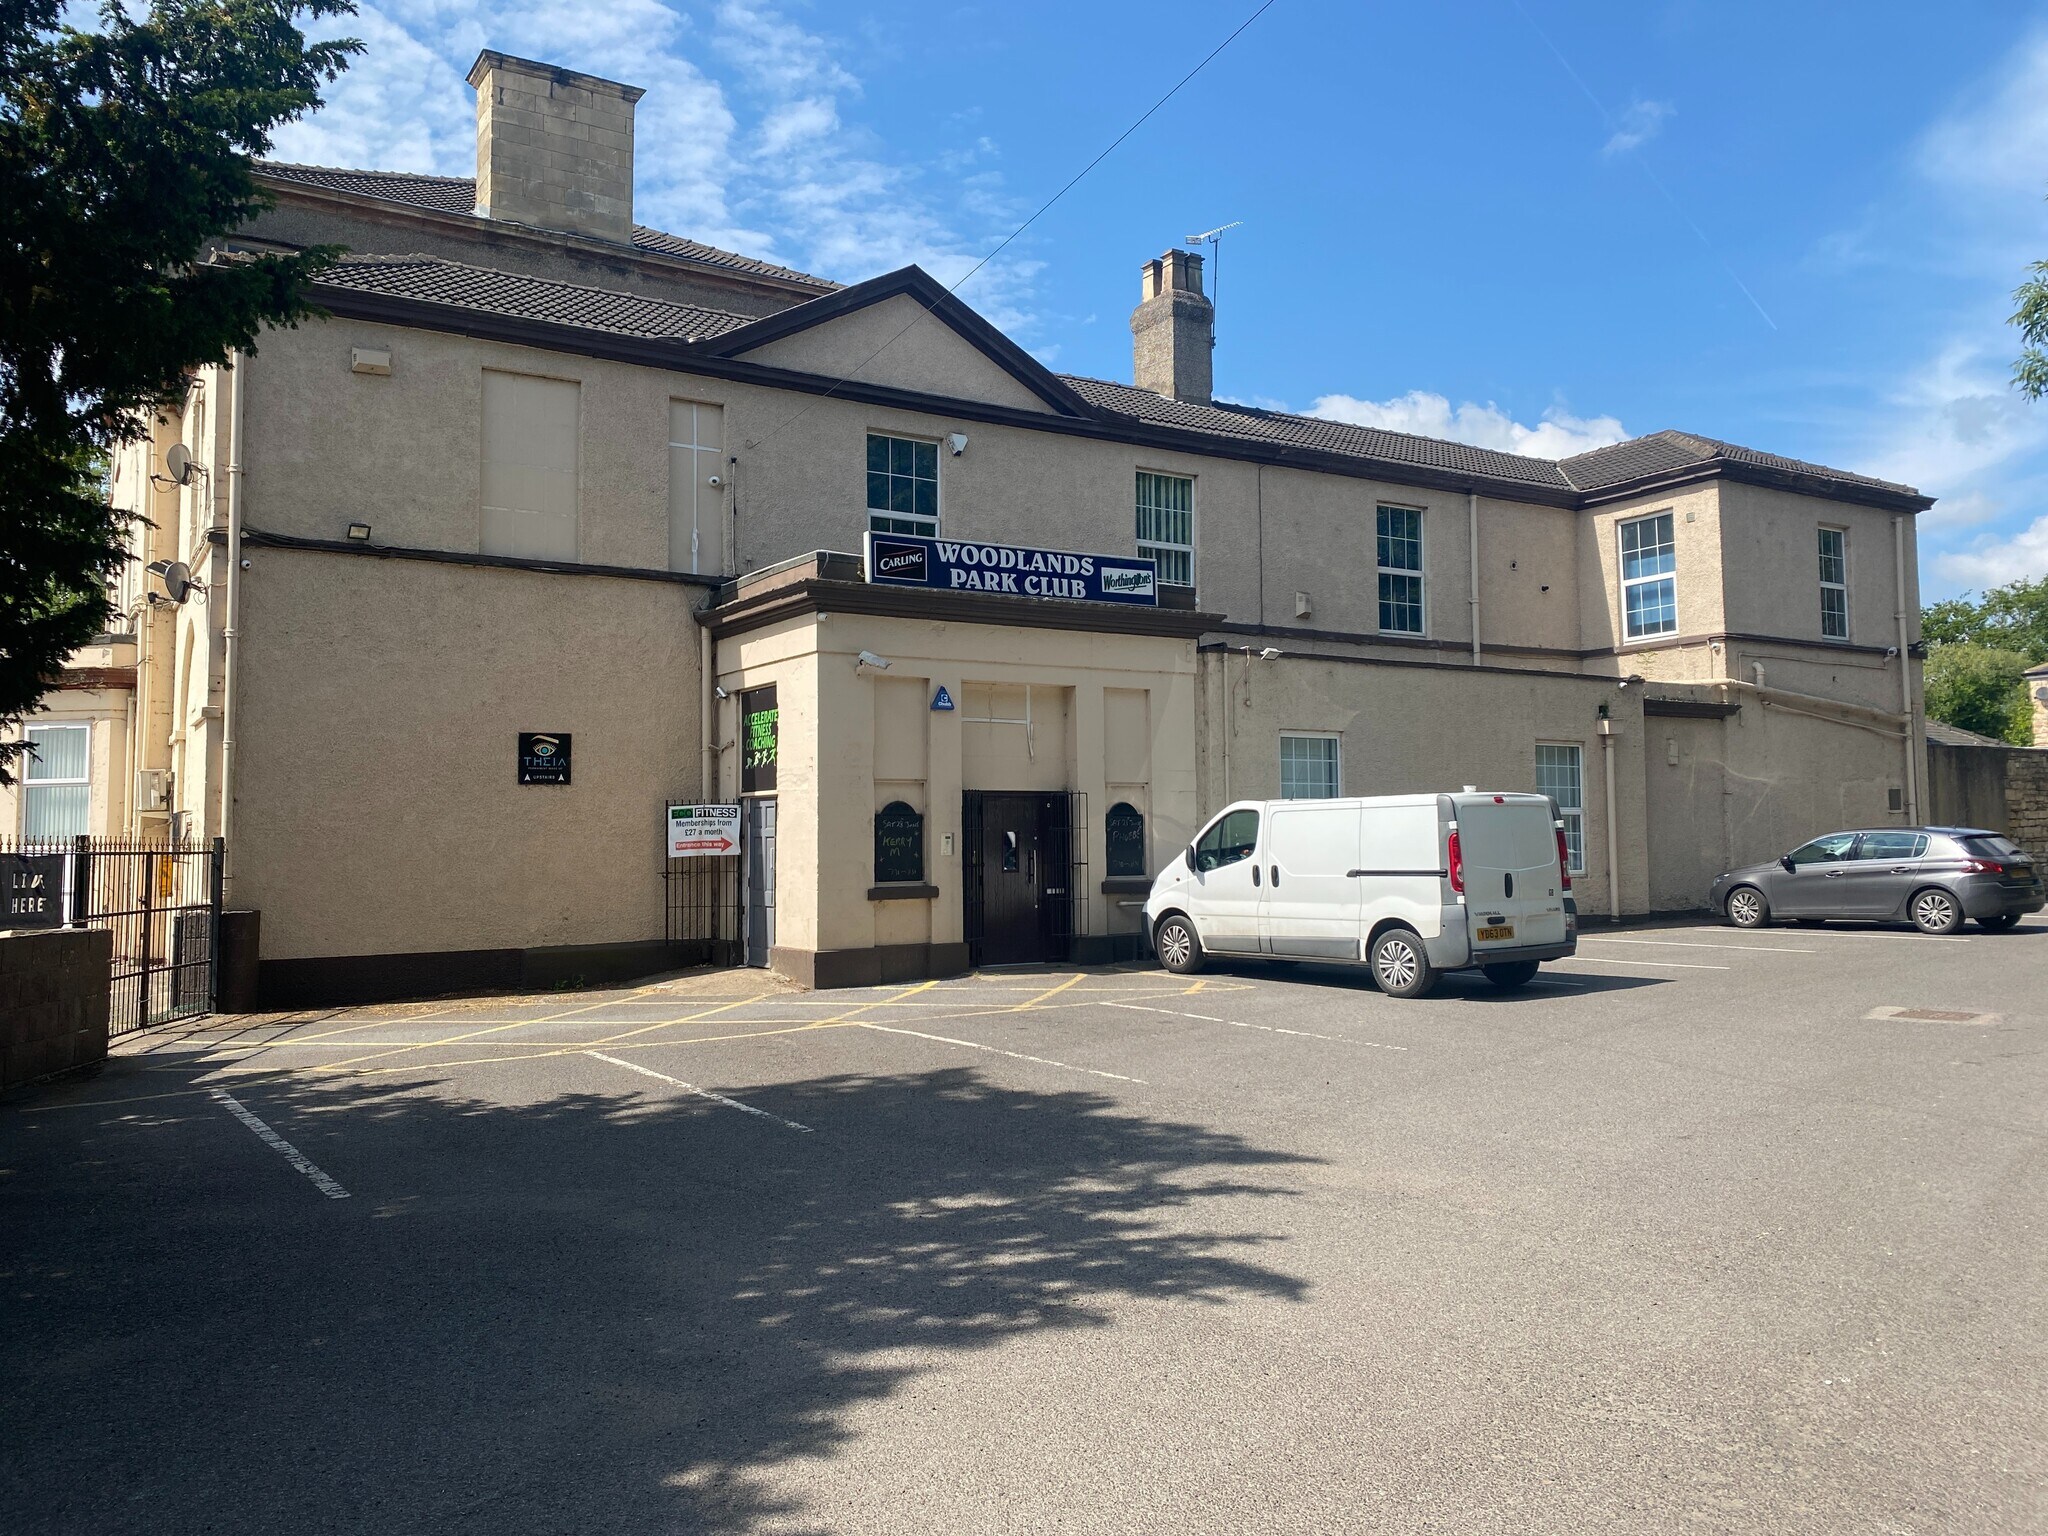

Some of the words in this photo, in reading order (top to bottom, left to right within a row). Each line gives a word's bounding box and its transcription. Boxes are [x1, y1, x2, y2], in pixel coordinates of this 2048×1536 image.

[880, 553, 923, 571] CARLING
[935, 541, 1095, 577] WOODLANDS
[950, 568, 1019, 594] PARK
[1024, 575, 1087, 599] CLUB
[744, 709, 779, 725] ACCELERATE
[749, 724, 772, 738] FITNESS
[746, 735, 775, 751] COACHING
[695, 808, 736, 817] FITNESS
[675, 819, 716, 827] Memberships
[882, 836, 913, 847] KERRY
[11, 896, 47, 913] HERE
[1480, 929, 1499, 939] YD63
[1499, 927, 1512, 937] OTN
